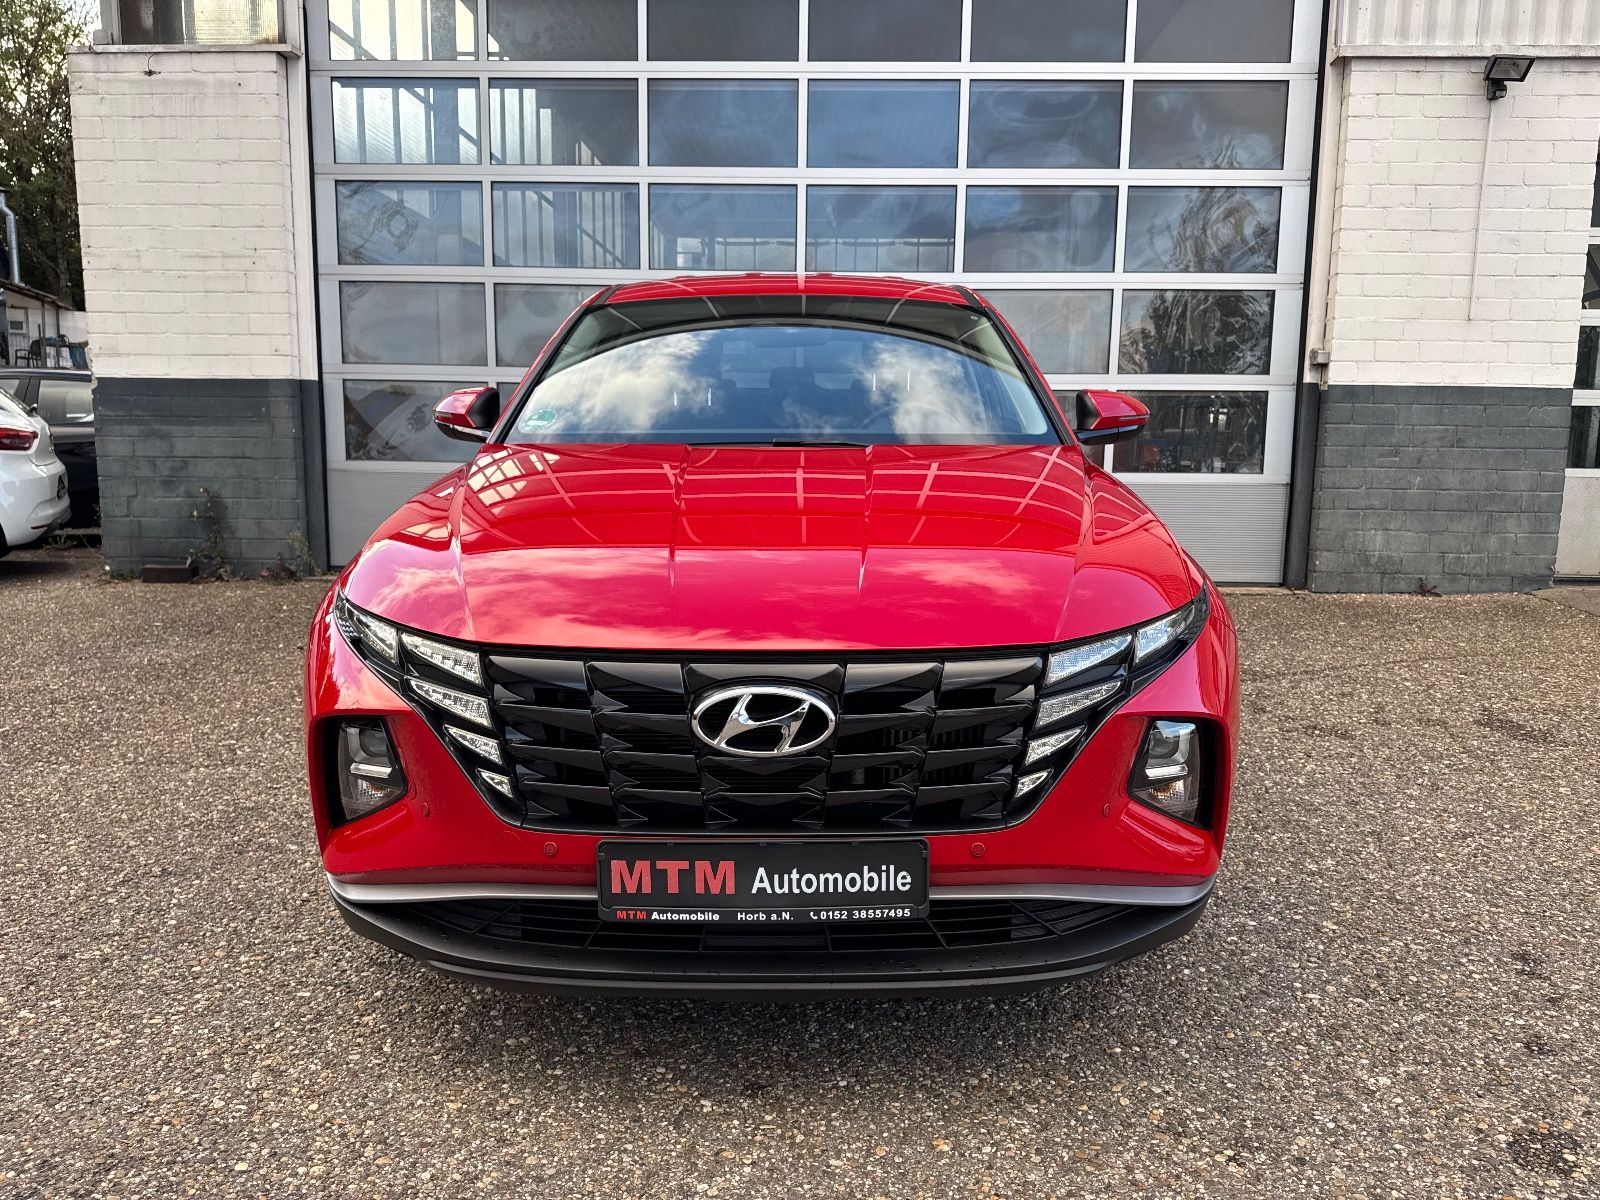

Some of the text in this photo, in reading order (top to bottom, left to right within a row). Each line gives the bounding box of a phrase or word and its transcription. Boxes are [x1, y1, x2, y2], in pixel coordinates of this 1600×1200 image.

[610, 860, 912, 894] MTM Automobile
[616, 908, 911, 921] MTM Automobile Horb a.N. 0152 38557495
